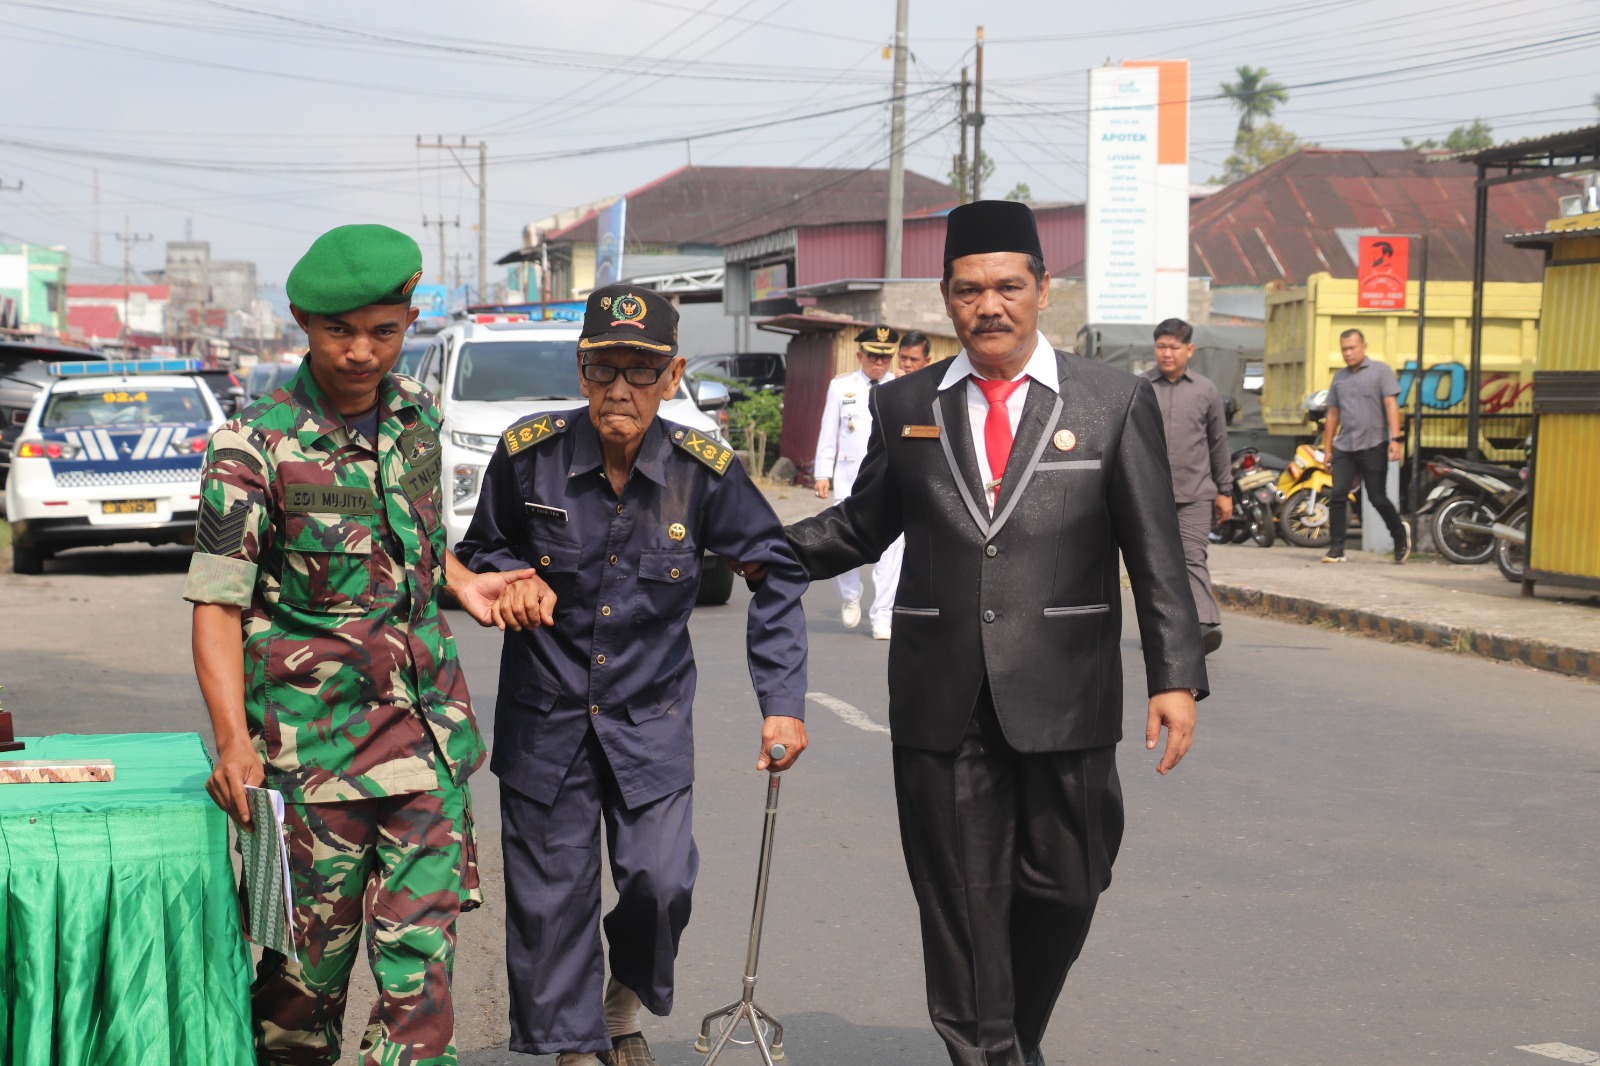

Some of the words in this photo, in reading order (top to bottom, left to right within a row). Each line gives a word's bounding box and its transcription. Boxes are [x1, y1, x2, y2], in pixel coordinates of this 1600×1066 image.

[1102, 133, 1148, 142] APOTEK
[103, 391, 148, 404] 92.4
[506, 430, 520, 452] LVRI
[714, 449, 731, 471] LVRI
[293, 492, 315, 506] EDI
[322, 492, 367, 510] MUJITO
